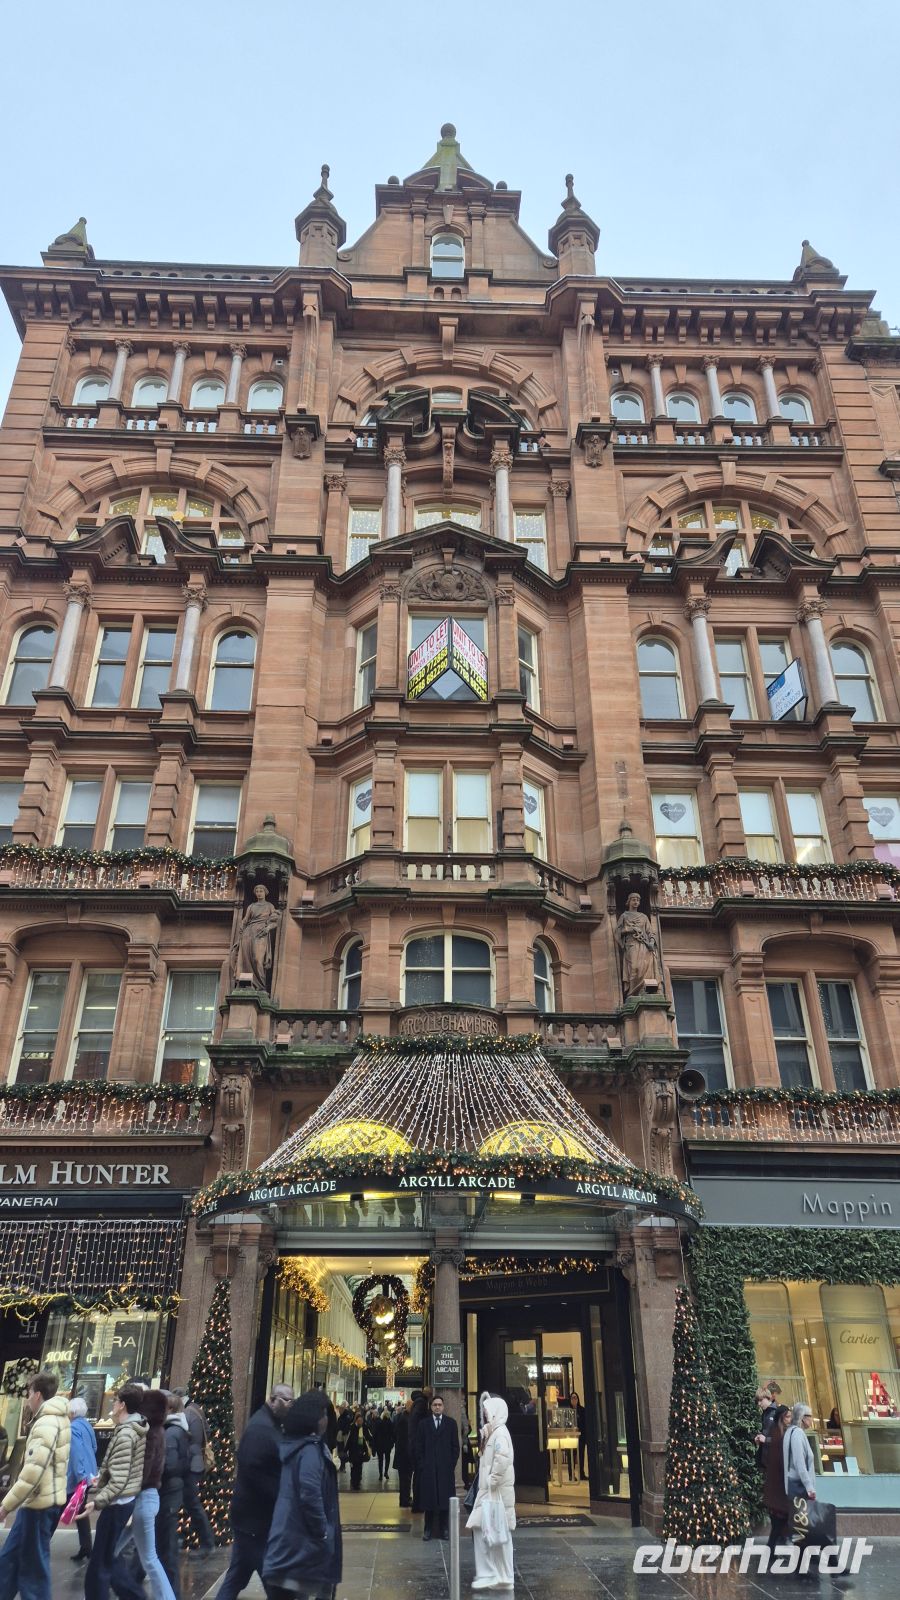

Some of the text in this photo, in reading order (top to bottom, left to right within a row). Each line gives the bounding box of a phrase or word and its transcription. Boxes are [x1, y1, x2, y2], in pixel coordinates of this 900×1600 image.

[410, 621, 448, 668] UNIT TO LET
[453, 622, 467, 643] UNIT
[468, 640, 476, 656] TO
[441, 1013, 498, 1036] CHAMBERS
[248, 1180, 337, 1202] ARGYLL ARCADE
[398, 1175, 516, 1188] ARGYLL ARCADE
[0, 1197, 59, 1207] ANERAI
[576, 1182, 658, 1204] ARGYLL ARCADE
[803, 1192, 893, 1222] Mappin
[840, 1329, 880, 1345] Cartier
[792, 1496, 809, 1543] M&S
